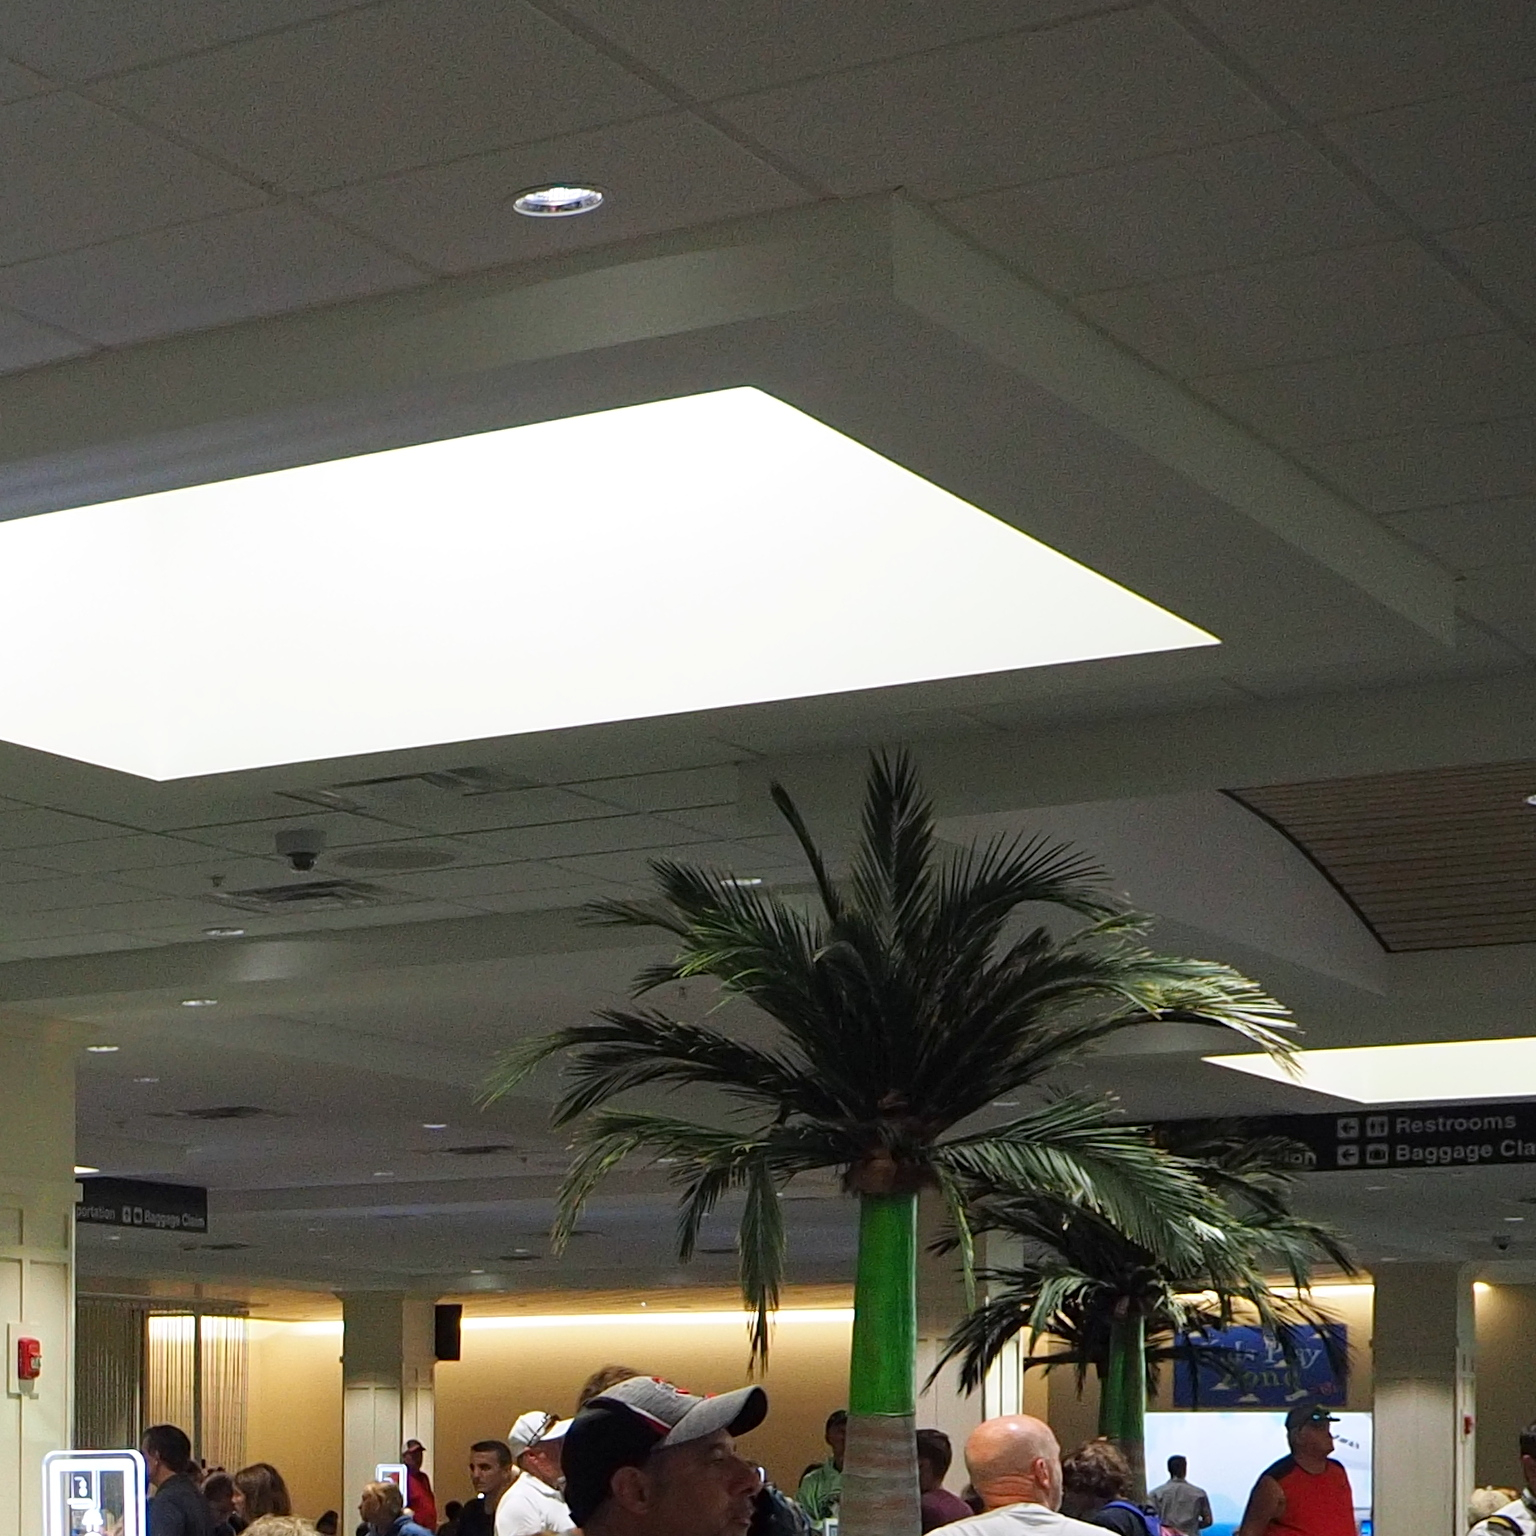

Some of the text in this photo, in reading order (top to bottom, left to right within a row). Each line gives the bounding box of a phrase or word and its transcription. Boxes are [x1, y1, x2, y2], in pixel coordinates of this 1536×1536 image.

[1396, 1115, 1516, 1134] Restrooms
[1396, 1144, 1493, 1163] Baggage
[144, 1209, 181, 1228] Baggage
